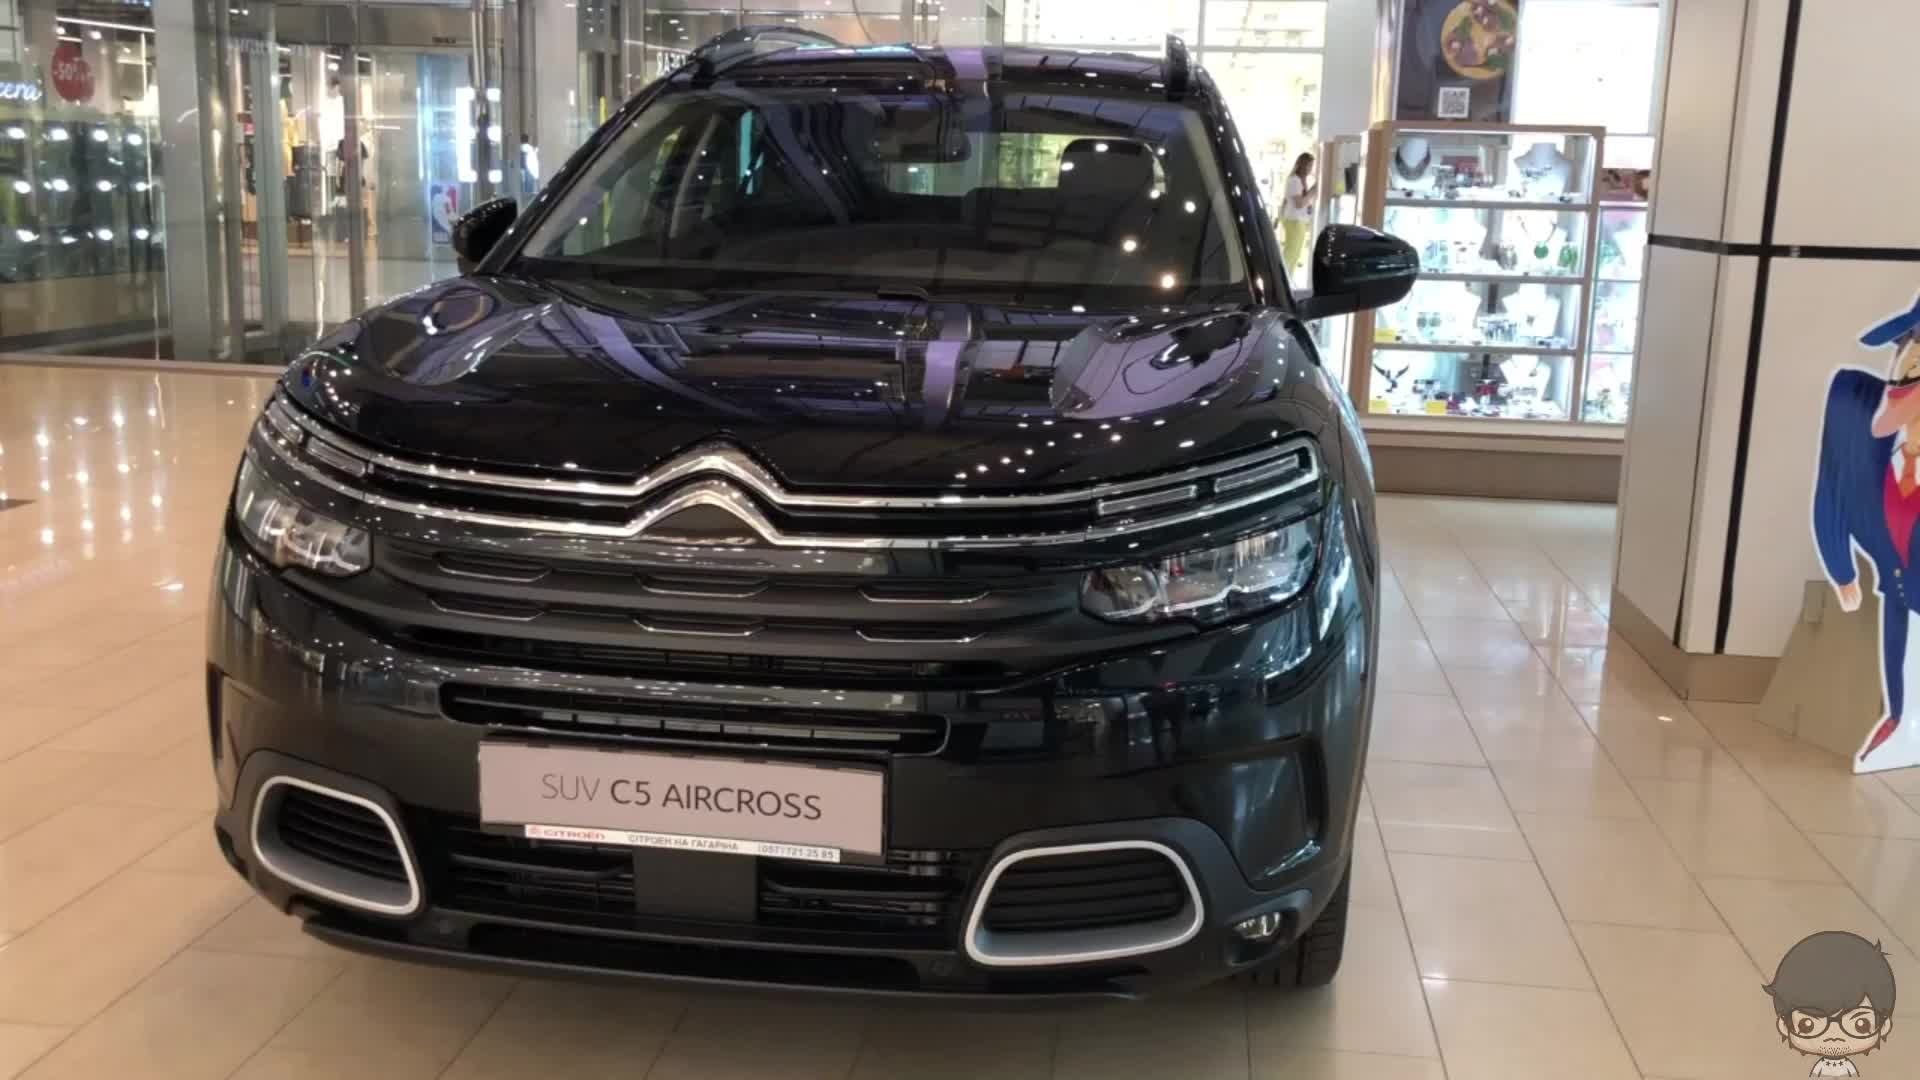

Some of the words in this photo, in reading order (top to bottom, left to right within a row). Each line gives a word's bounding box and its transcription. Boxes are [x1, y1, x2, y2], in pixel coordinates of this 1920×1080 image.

[541, 773, 600, 802] SUV
[610, 778, 651, 807] C5
[661, 783, 823, 821] AIRCROSS
